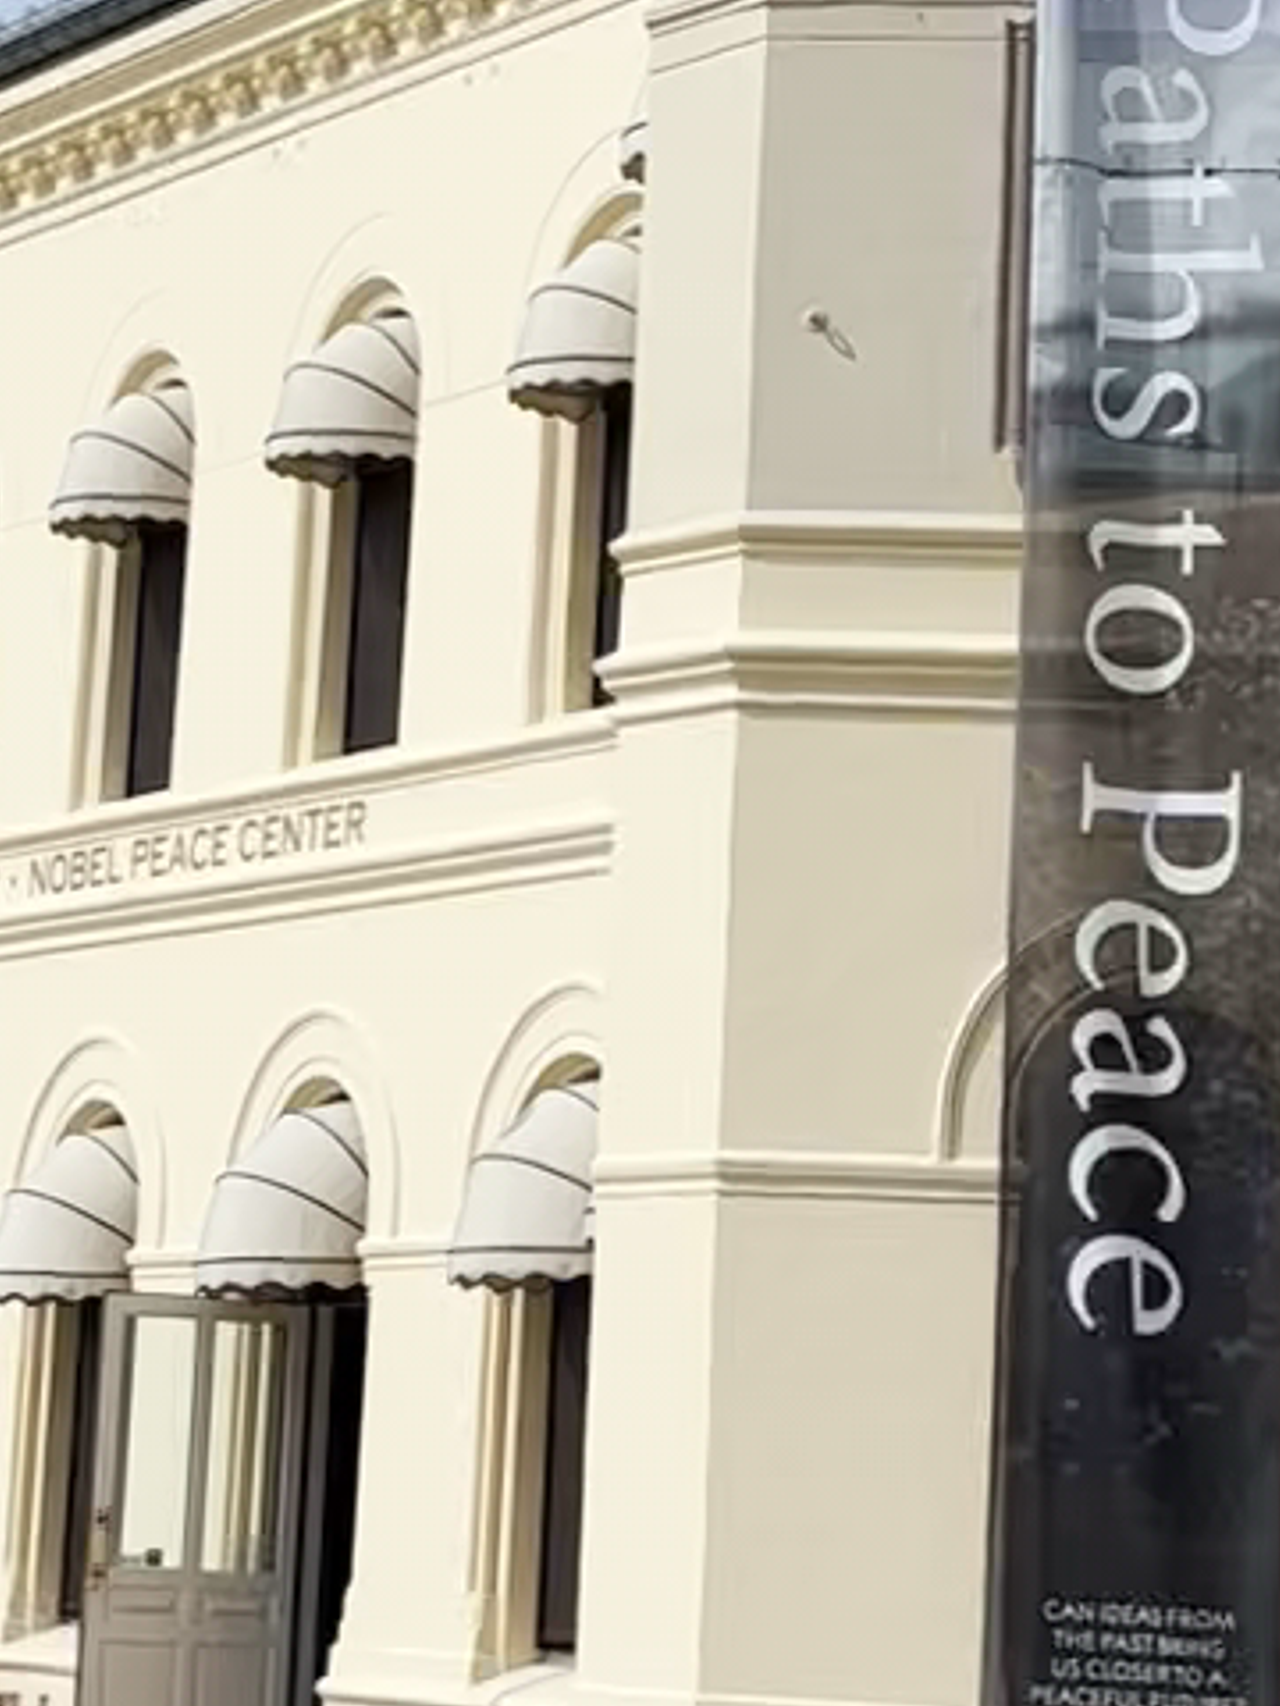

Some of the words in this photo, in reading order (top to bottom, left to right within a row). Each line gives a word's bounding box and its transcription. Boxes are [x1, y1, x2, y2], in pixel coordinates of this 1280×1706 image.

[1083, 508, 1226, 693] to
[26, 845, 122, 897] NOBEL
[129, 824, 231, 880] PEACE
[236, 800, 367, 862] CENTER
[1066, 761, 1242, 1335] Peace
[1042, 1597, 1095, 1623] CAN
[1100, 1602, 1161, 1629] IDEAS
[1166, 1606, 1236, 1633] FROM
[1053, 1629, 1096, 1653] THE
[1100, 1631, 1155, 1657] PAST
[1050, 1658, 1081, 1681] US
[1085, 1659, 1170, 1685] CLOSER
[1174, 1665, 1204, 1689] TO
[1207, 1669, 1228, 1691] A
